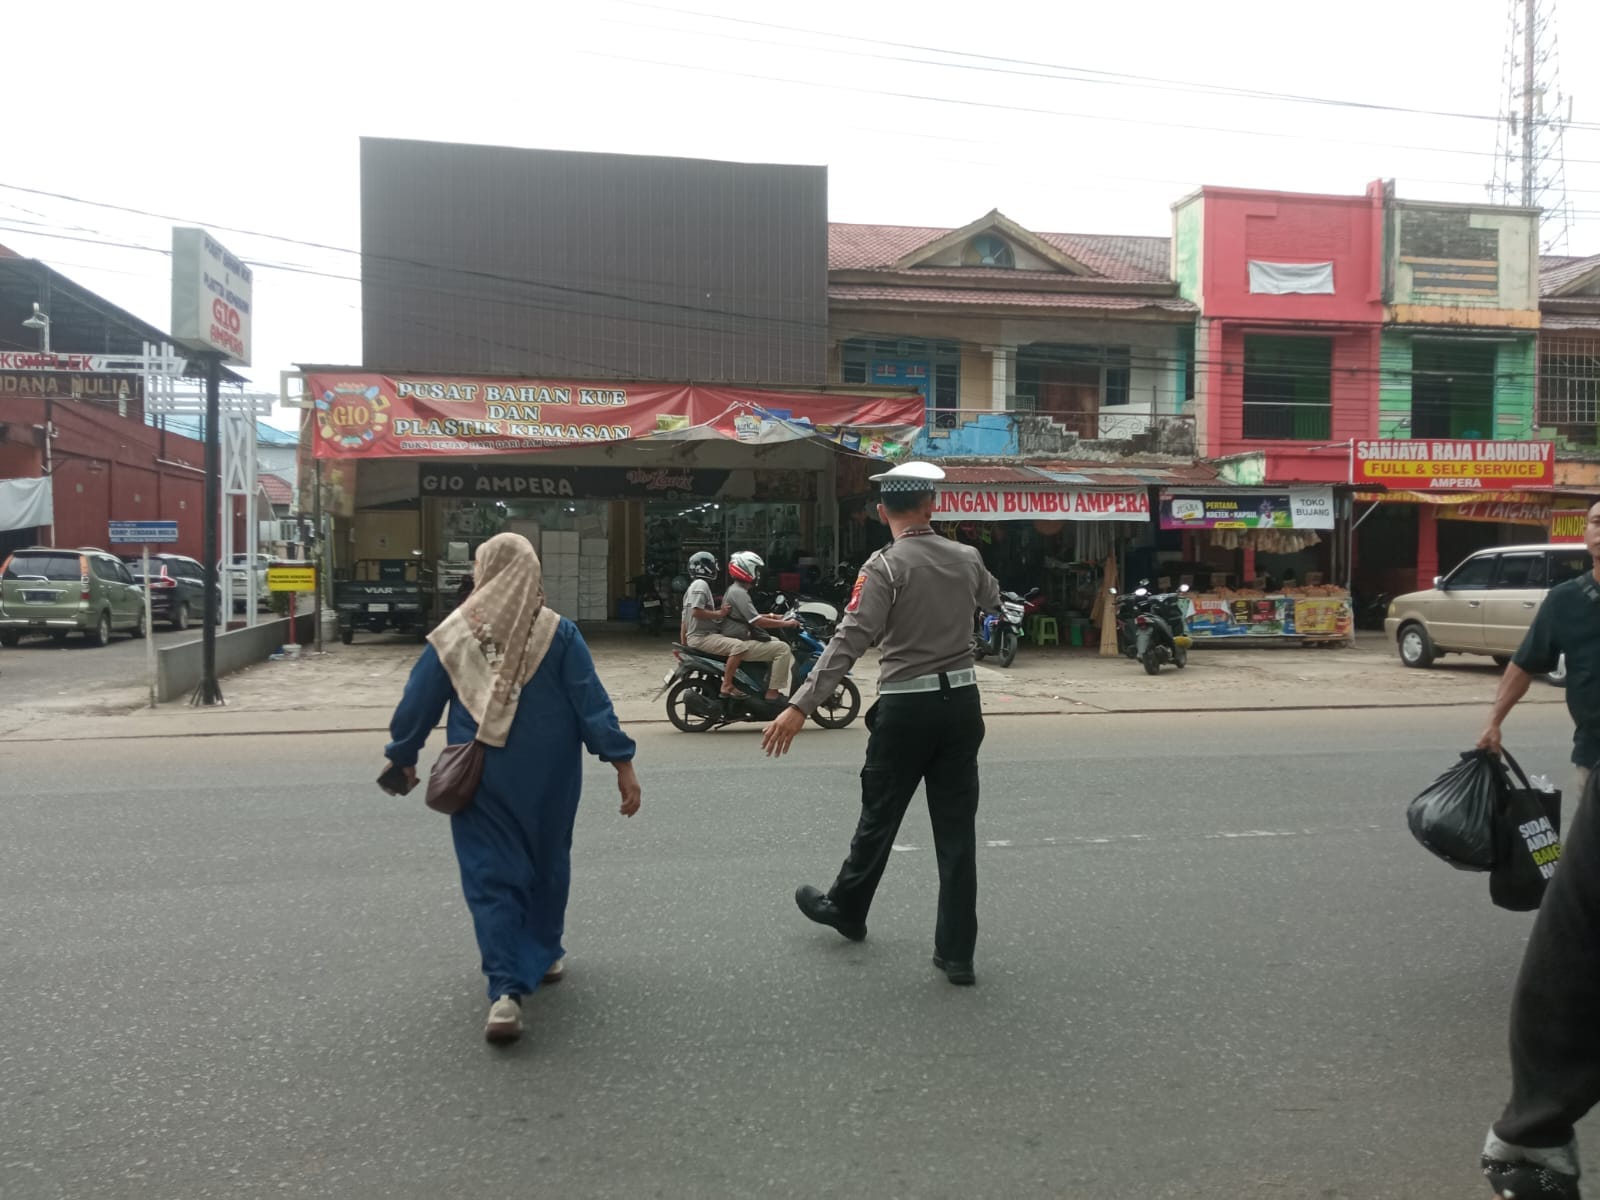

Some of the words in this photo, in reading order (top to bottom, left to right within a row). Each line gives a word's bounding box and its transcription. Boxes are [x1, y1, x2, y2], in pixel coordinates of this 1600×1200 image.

[212, 297, 240, 335] GIO
[210, 324, 243, 357] AMPERA
[0, 353, 94, 371] KOMPLEK
[0, 375, 59, 393] DANA
[72, 377, 131, 394] MULIA
[396, 382, 477, 401] PUSAT
[485, 386, 571, 405] BAHAN
[579, 388, 627, 406] KUE
[332, 405, 369, 426] GIO
[488, 404, 540, 421] DAN
[394, 417, 501, 437] PLASTIK
[509, 422, 631, 441] KEMASAN
[1357, 441, 1429, 460] SANJAYA
[1432, 442, 1473, 460] RAJA
[1476, 442, 1551, 461] LAUNDRY
[1371, 463, 1409, 475] FULL
[1416, 464, 1425, 475] &
[1431, 463, 1468, 475] SELF
[1473, 463, 1537, 475] SERVICE
[423, 475, 464, 491] GIO
[475, 476, 574, 496] AMPERA
[1429, 478, 1481, 488] AMPERA
[932, 490, 998, 513] LINGAN
[1002, 491, 1071, 513] BUMBU
[1074, 492, 1149, 513] AMPERA
[1205, 502, 1238, 510] PERTAMA
[1300, 498, 1325, 507] TOKO
[1296, 508, 1329, 517] BUJANG
[1552, 515, 1585, 537] LAUNDR
